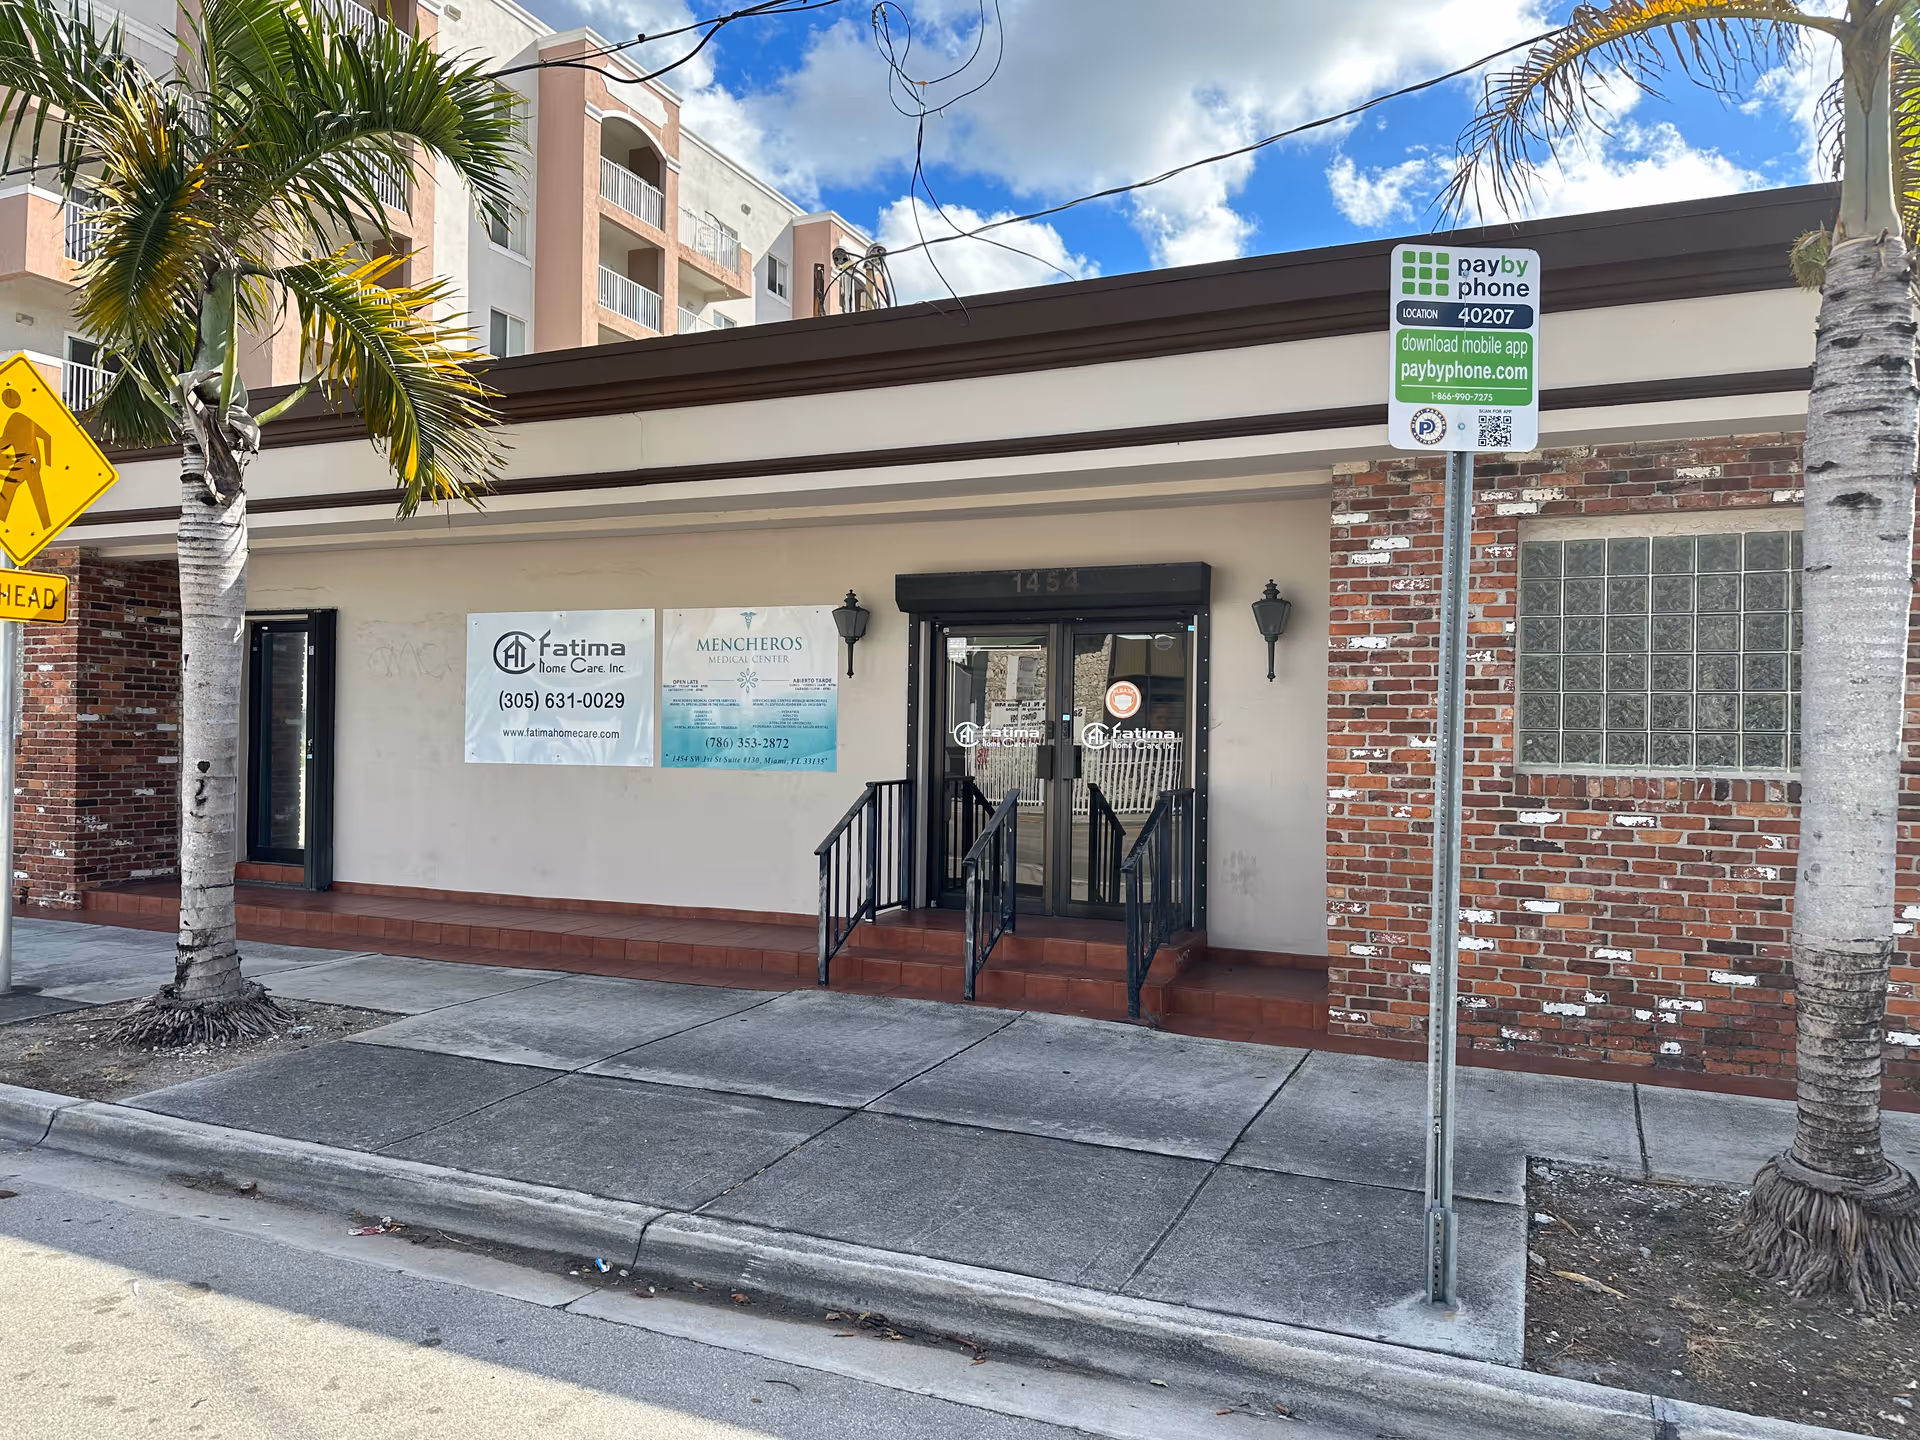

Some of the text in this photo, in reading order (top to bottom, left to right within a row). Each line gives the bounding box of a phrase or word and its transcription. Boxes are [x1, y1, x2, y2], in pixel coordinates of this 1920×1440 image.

[1458, 277, 1530, 299] phone
[1403, 308, 1438, 319] LOCATION
[1458, 307, 1514, 324] 40207
[1402, 333, 1528, 359] download mobile app
[1401, 359, 1528, 382] paybyphone.com
[1431, 392, 1493, 401] 1-866-990-7275
[1012, 571, 1079, 593] 1454
[696, 636, 803, 651] MENCHEROS
[708, 655, 790, 664] MEDICAL CENTER
[499, 690, 625, 711] (305) 631-0029
[502, 728, 620, 739] www.fatimahomecare.com
[705, 737, 790, 749] (786) 353-2872
[764, 757, 789, 765] Miami,
